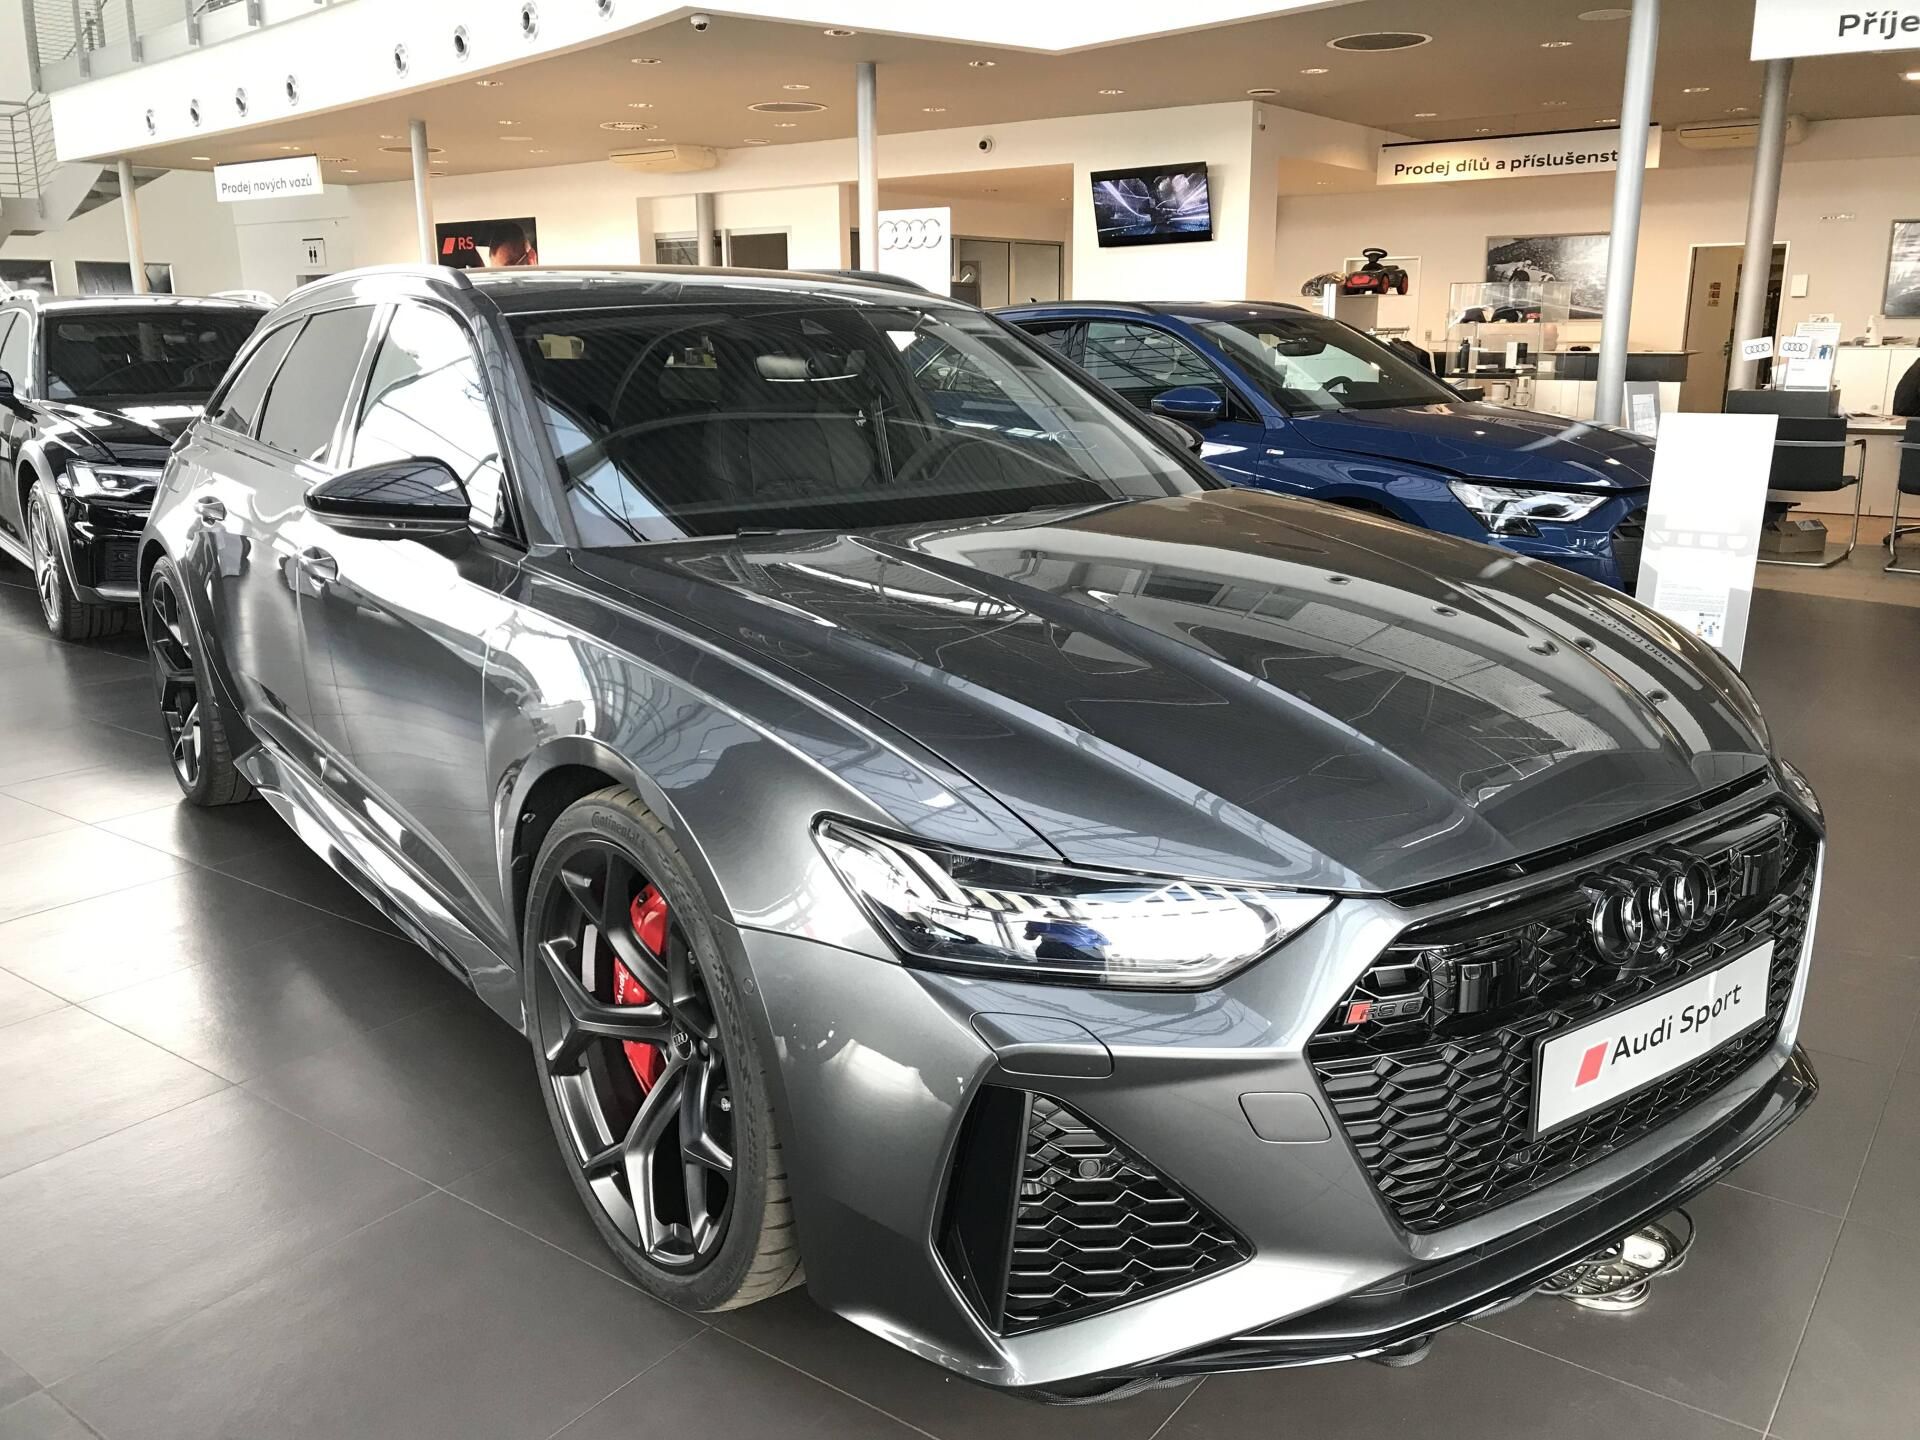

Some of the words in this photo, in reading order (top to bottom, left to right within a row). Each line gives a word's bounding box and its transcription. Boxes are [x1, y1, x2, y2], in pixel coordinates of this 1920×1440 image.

[1394, 160, 1450, 176] Prodej
[1456, 157, 1490, 173] dílů
[1495, 159, 1506, 170] a
[1510, 148, 1619, 172] příslušenst
[221, 181, 252, 195] Prodej
[253, 177, 287, 192] nových
[288, 173, 313, 188] vozů
[457, 236, 475, 251] RS
[591, 811, 641, 846] Continental
[1360, 1002, 1397, 1020] RS
[1610, 1014, 1674, 1066] Audi
[1679, 983, 1743, 1034] Sport
